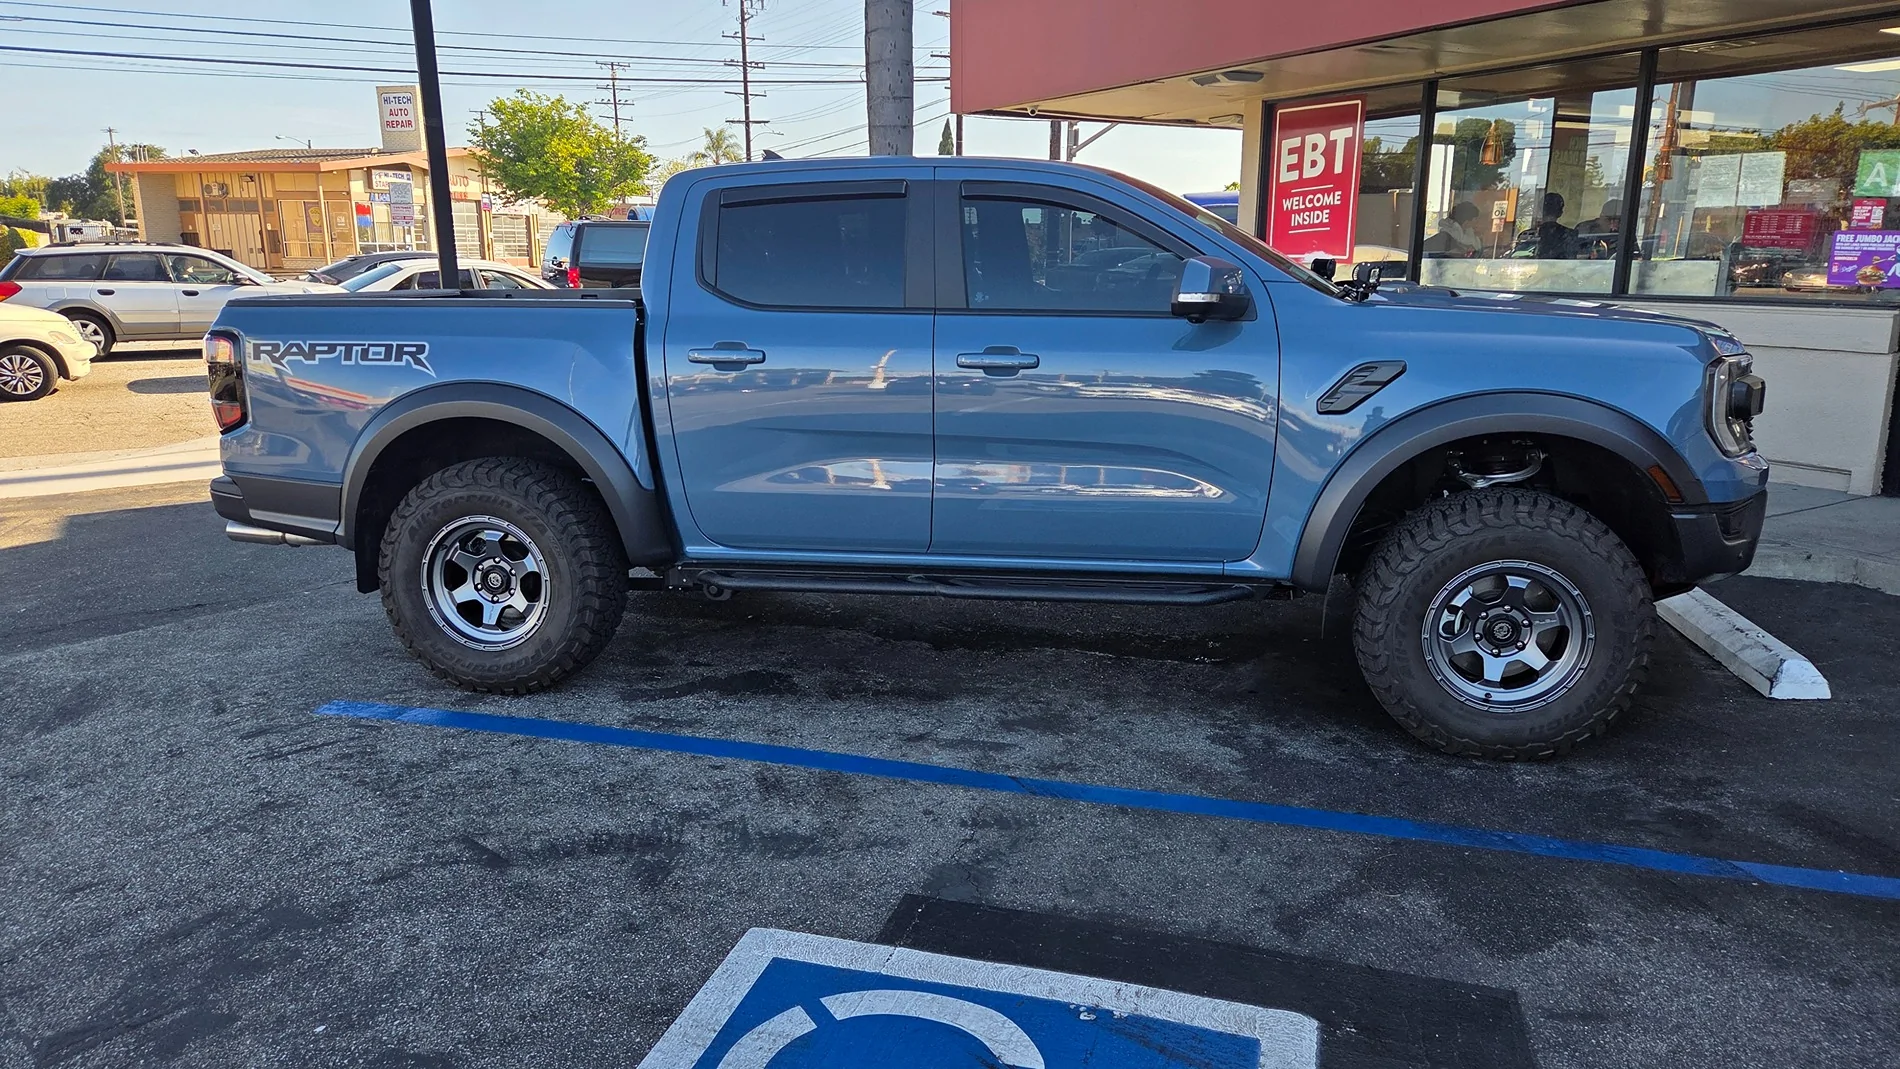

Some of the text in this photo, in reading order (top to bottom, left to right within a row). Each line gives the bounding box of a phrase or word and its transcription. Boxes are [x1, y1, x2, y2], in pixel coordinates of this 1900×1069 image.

[383, 96, 412, 105] HI-TECH
[389, 108, 409, 116] AUTO
[386, 120, 413, 129] REPAIR
[1279, 126, 1353, 183] EBT
[1863, 162, 1888, 187] A
[1282, 191, 1342, 211] WELCOME
[1291, 210, 1330, 226] INSIDE
[1836, 234, 1855, 242] FREE
[1855, 234, 1882, 242] JUMBO
[251, 341, 436, 377] RAPTOR
